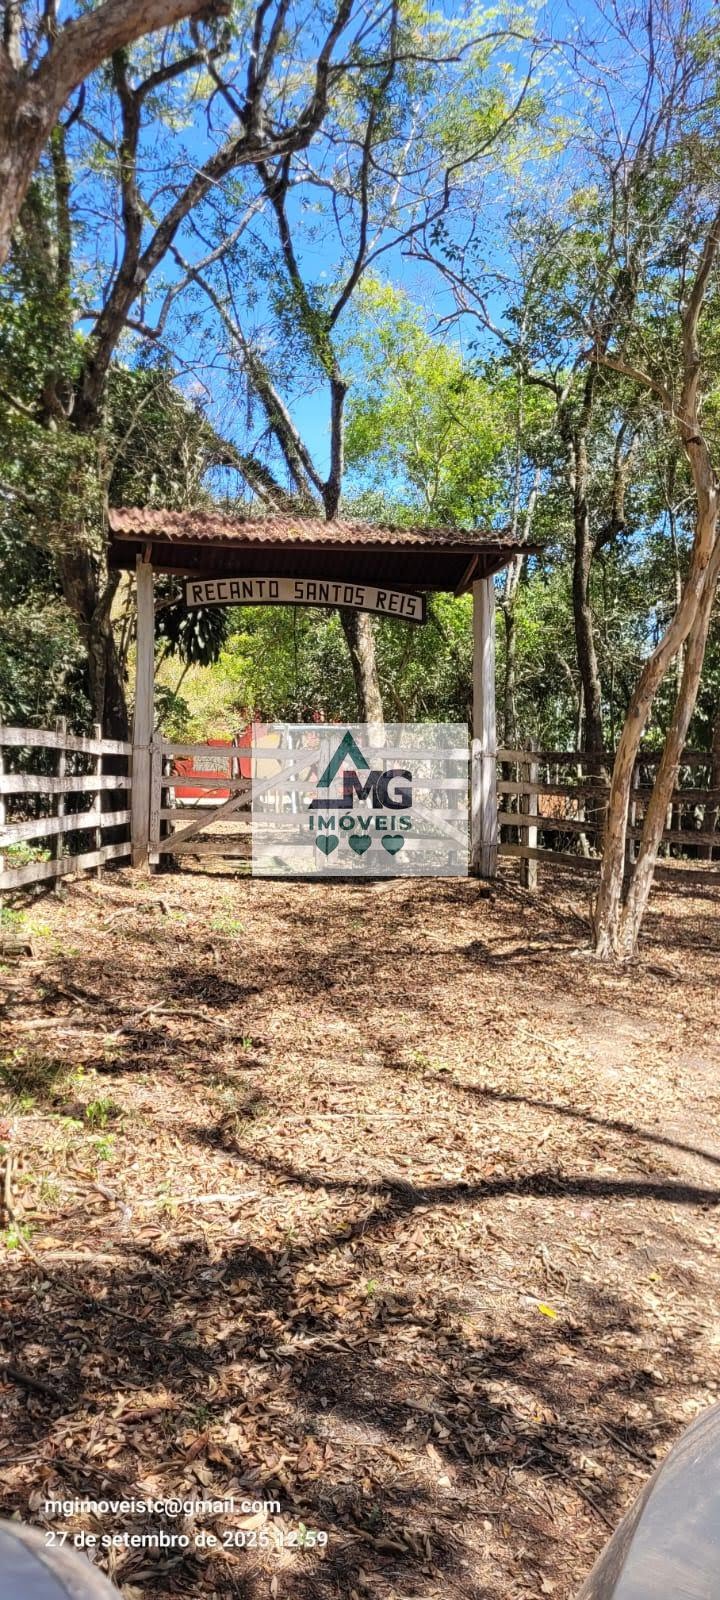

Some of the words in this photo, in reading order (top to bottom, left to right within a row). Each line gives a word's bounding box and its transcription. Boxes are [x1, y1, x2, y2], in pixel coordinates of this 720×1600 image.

[192, 580, 279, 603] RECANTO
[294, 581, 365, 606] SANTOS
[375, 590, 417, 616] REIS
